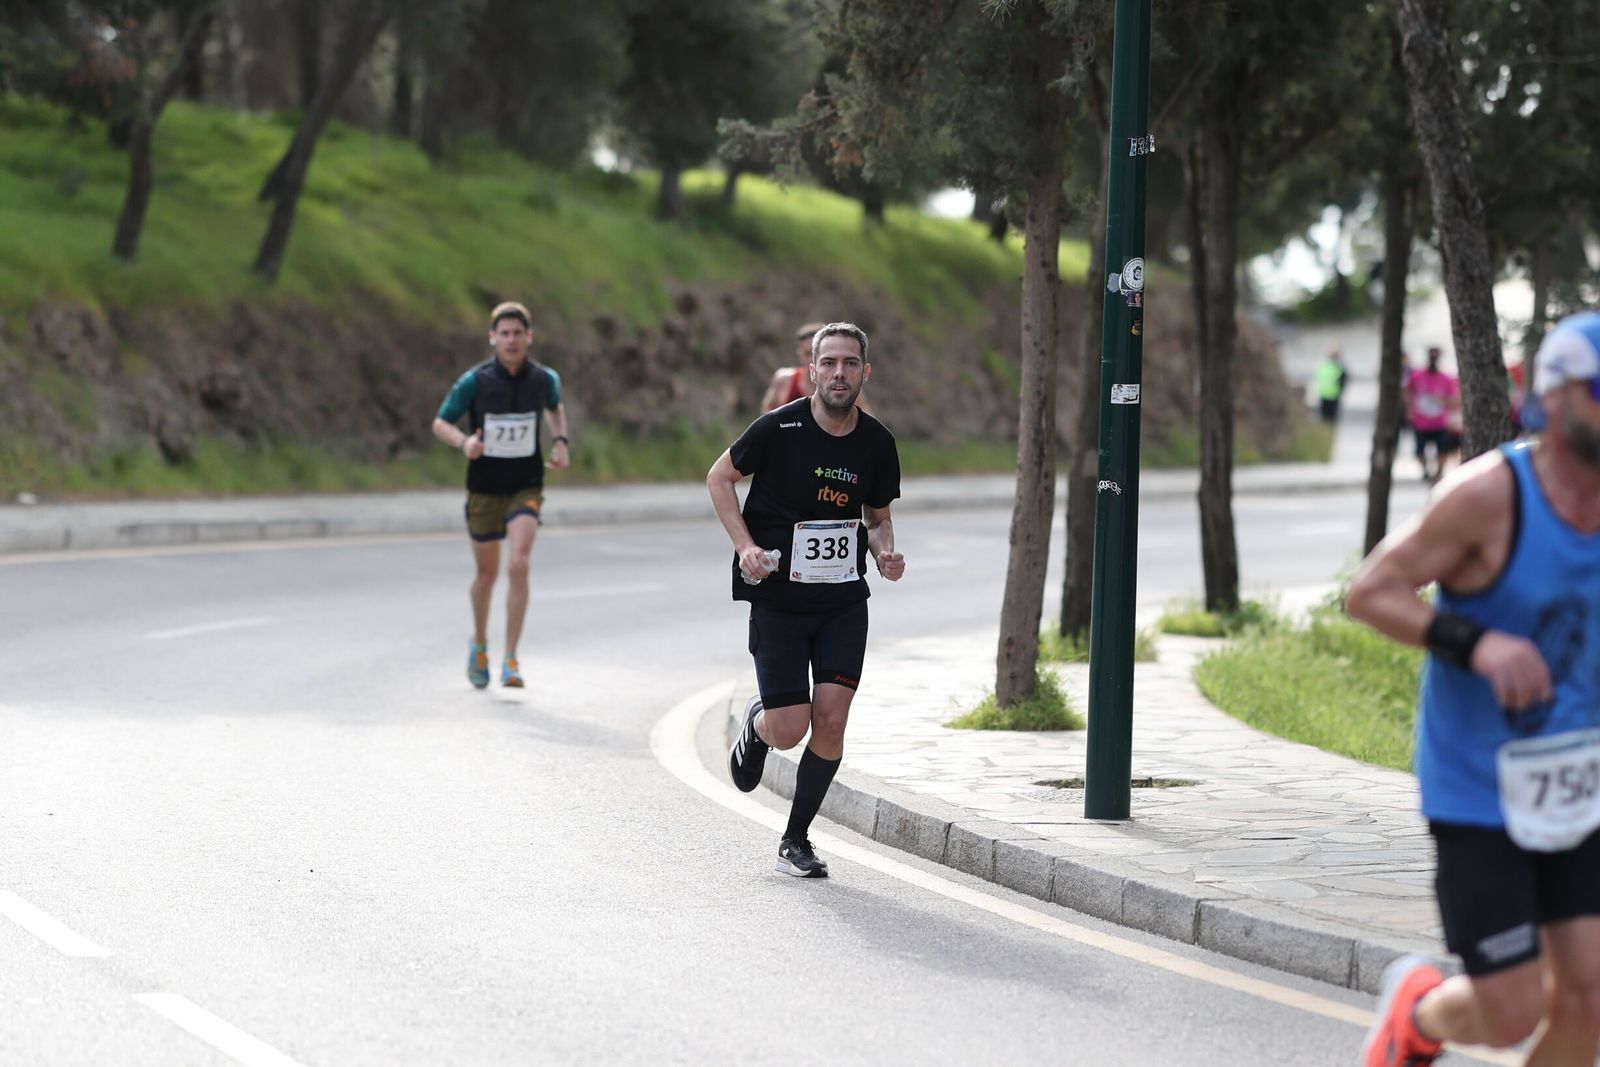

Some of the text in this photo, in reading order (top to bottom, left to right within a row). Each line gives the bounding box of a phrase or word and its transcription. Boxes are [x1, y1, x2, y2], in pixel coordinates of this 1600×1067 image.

[495, 425, 528, 441] 717
[817, 486, 849, 508] rtve
[805, 536, 849, 560] 338
